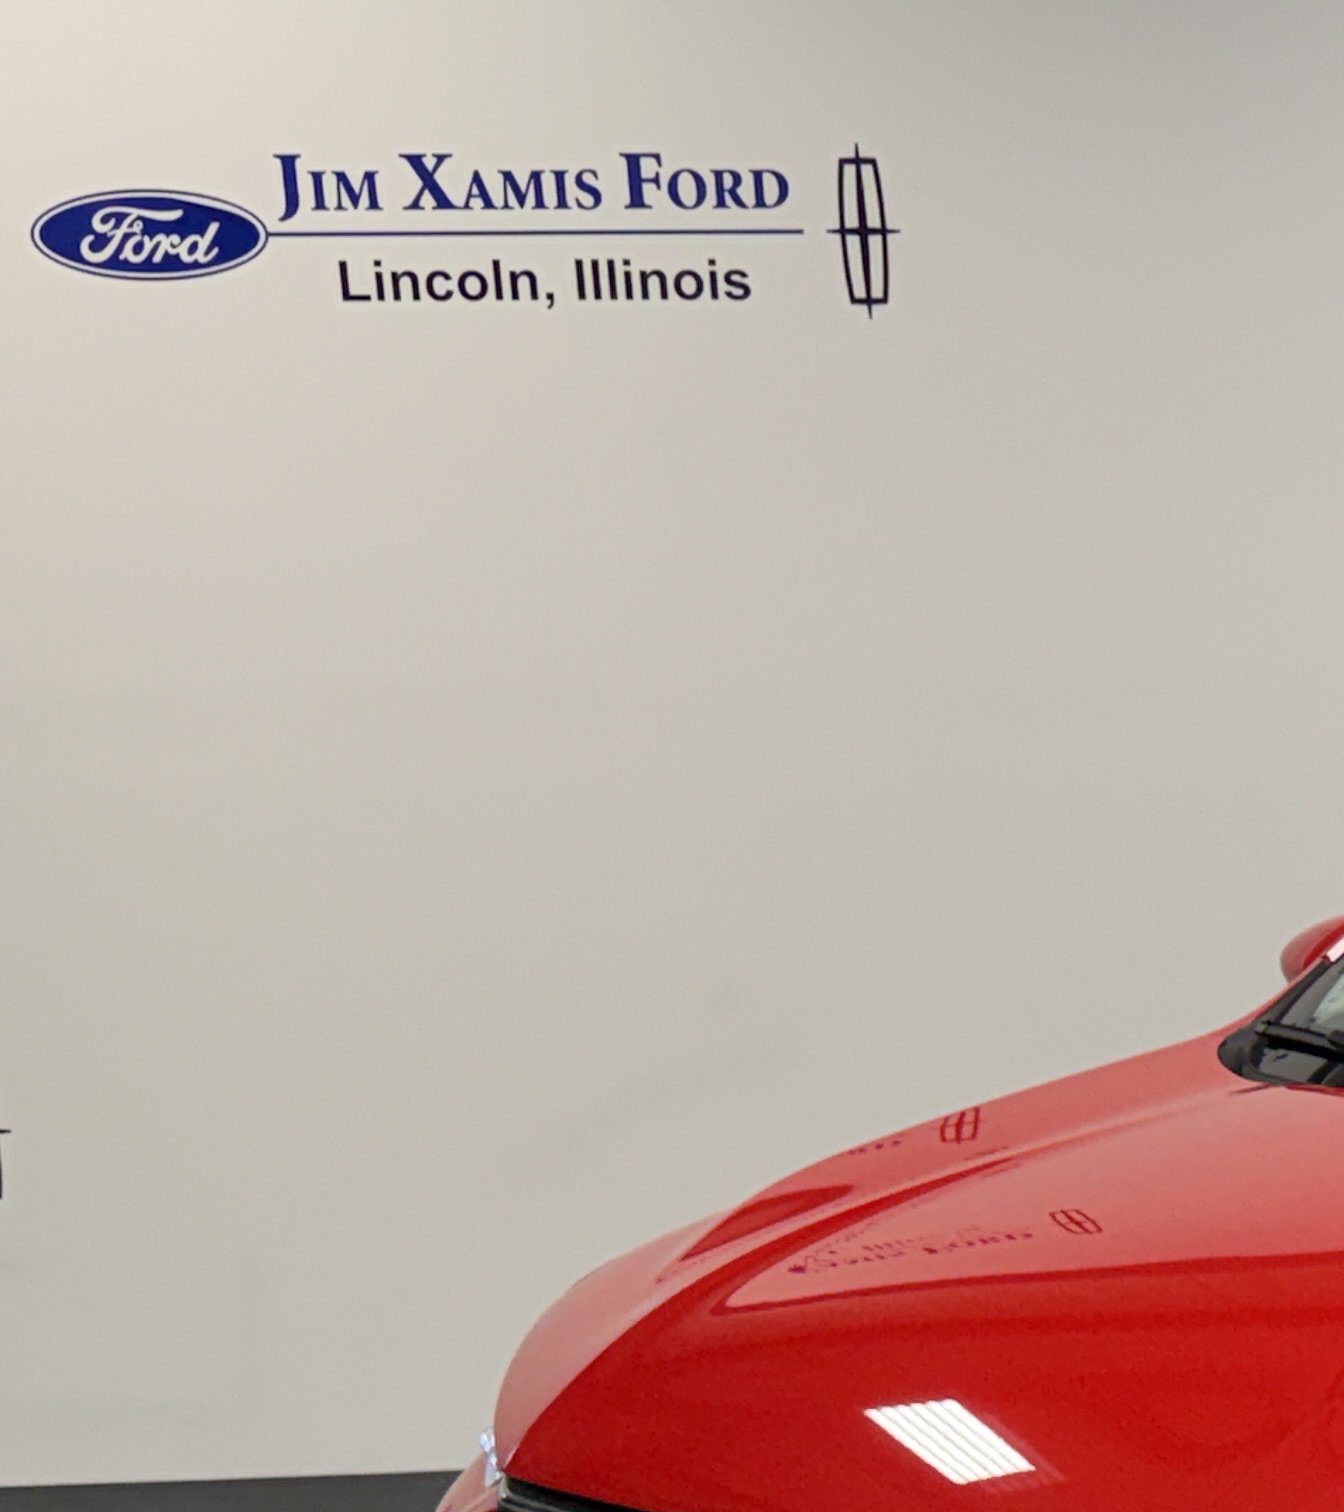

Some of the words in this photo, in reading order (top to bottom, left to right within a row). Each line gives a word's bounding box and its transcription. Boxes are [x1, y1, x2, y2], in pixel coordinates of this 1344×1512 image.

[272, 152, 381, 223] JIM
[399, 152, 604, 212] XAMIS
[618, 151, 791, 210] FORD
[79, 203, 220, 267] Ford
[338, 259, 556, 310] Lincoln,
[575, 258, 752, 302] Illinois
